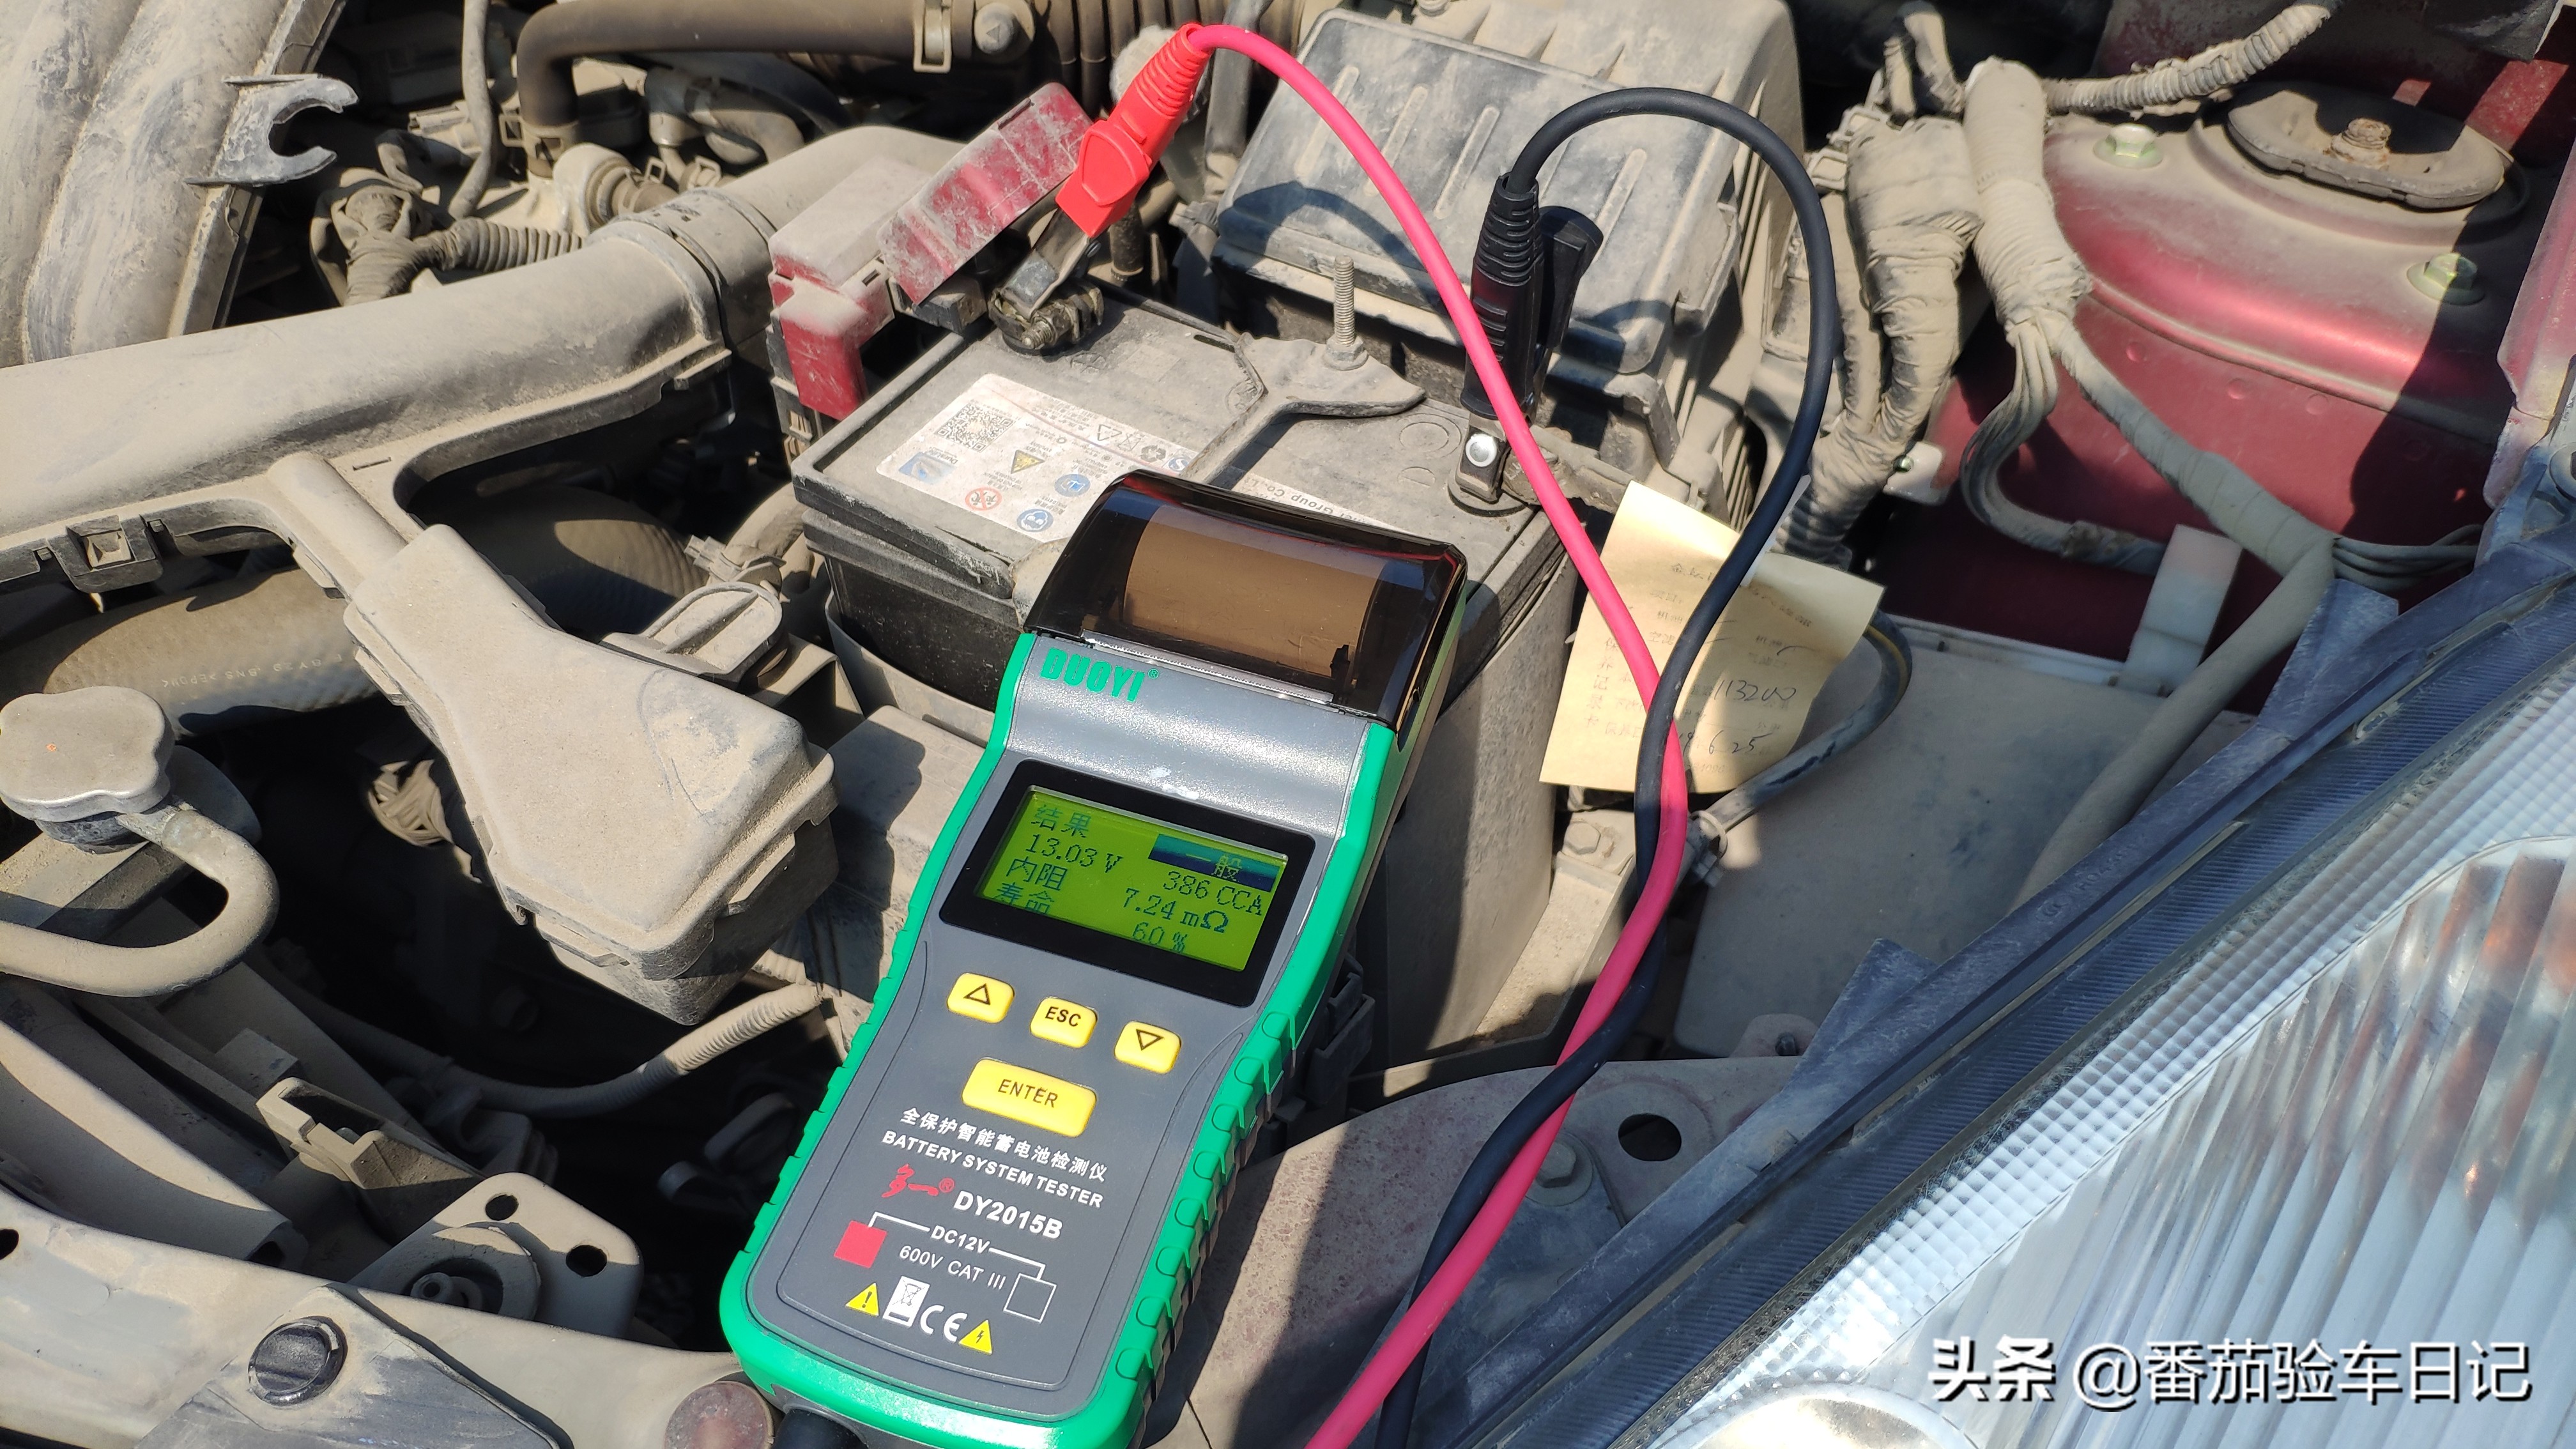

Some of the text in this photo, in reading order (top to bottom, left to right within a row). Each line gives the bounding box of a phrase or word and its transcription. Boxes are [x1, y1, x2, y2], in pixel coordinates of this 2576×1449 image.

[1290, 494, 1334, 516] Group
[1040, 647, 1146, 703] DUOYI
[1708, 730, 1724, 755] 6
[1030, 804, 1242, 883] 结果 一般
[1006, 855, 1068, 891] 内阻
[1123, 887, 1177, 921] 7.24
[1025, 834, 1262, 916] 13.03 V 386 CCA
[1131, 921, 1165, 946] 60
[1172, 931, 1188, 953] %
[1045, 1006, 1082, 1027] ESC
[997, 1078, 1059, 1108] ENTER
[881, 1130, 1104, 1208] BATTERY SYSTEM TESTER
[900, 1107, 1108, 1183] 全保护智能蓄电池检测仪
[953, 1190, 1064, 1240] DY2015B
[930, 1225, 990, 1254] DC12V
[898, 1245, 1007, 1291] 600V CAT III
